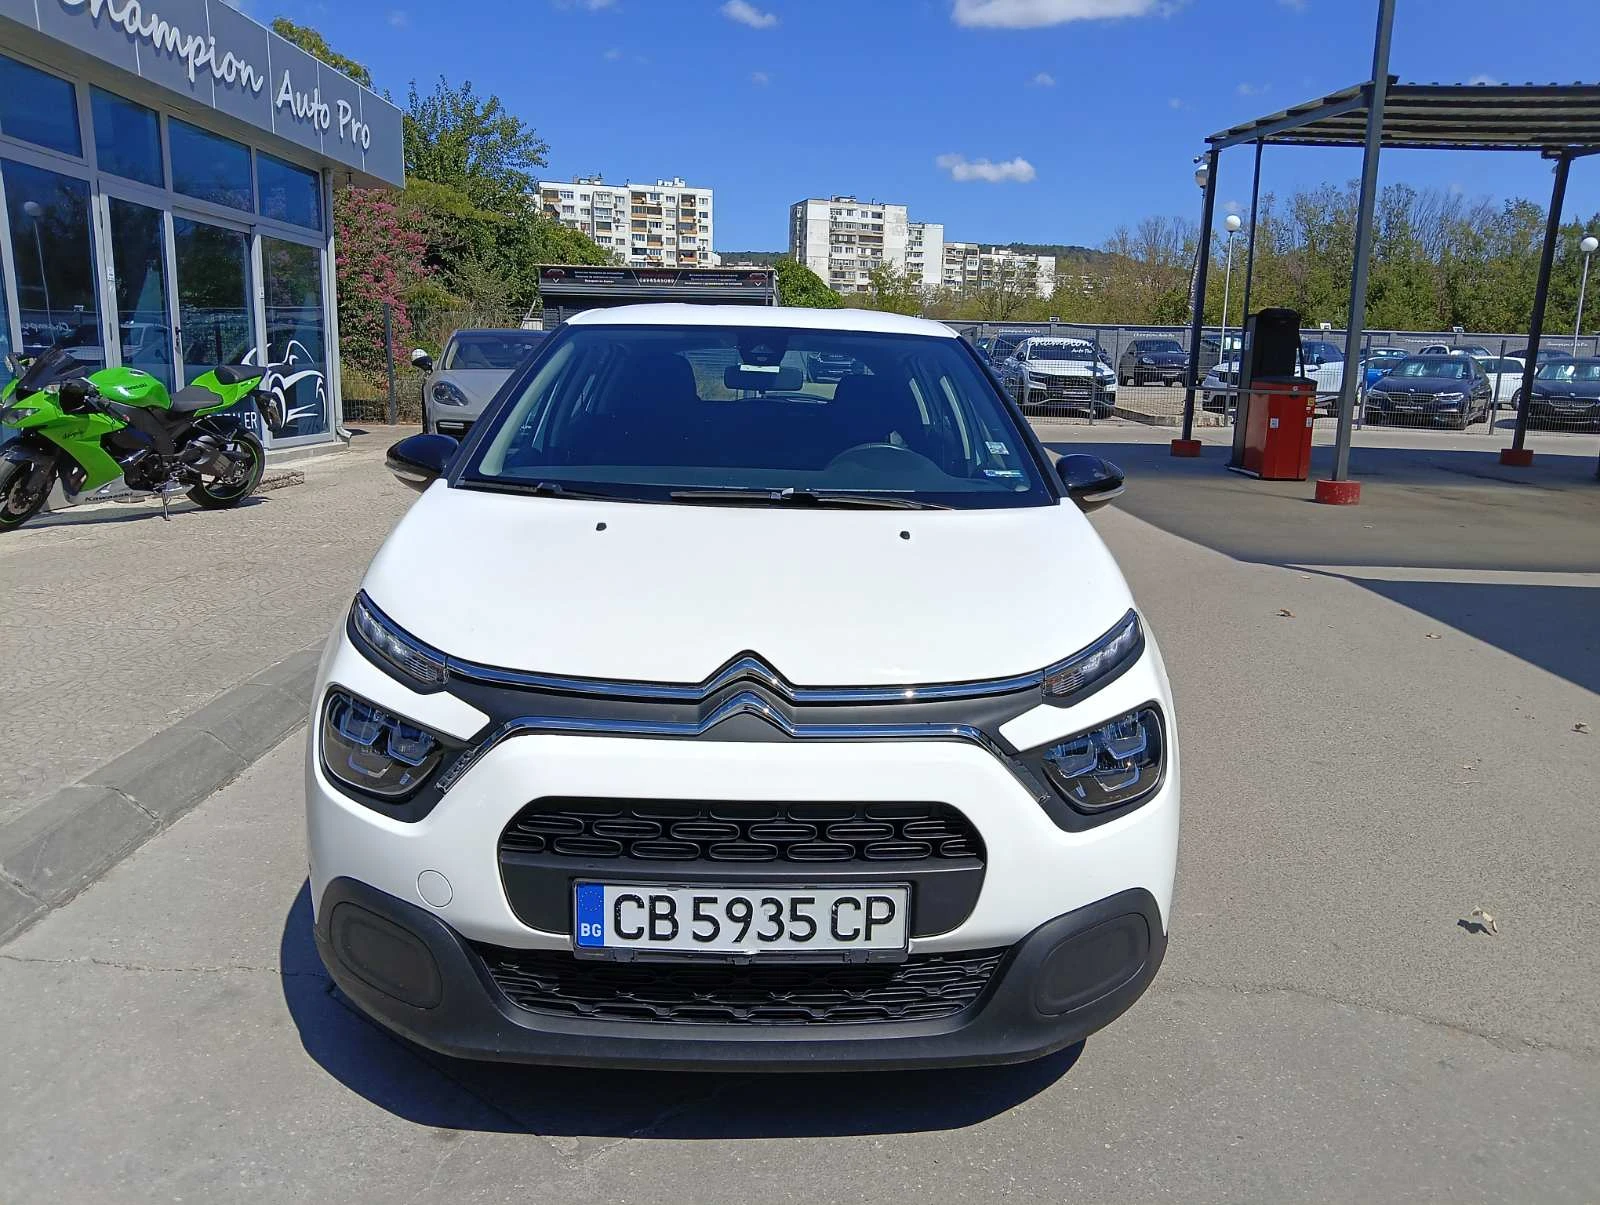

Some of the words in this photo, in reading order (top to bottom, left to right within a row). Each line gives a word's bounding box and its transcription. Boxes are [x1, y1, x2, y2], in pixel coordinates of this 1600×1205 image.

[63, 0, 264, 92] ampion
[276, 69, 330, 130] Auto
[336, 99, 370, 149] Pro
[580, 923, 602, 938] BG
[613, 893, 679, 941] CB
[691, 896, 818, 943] 5935
[830, 896, 896, 942] CP
